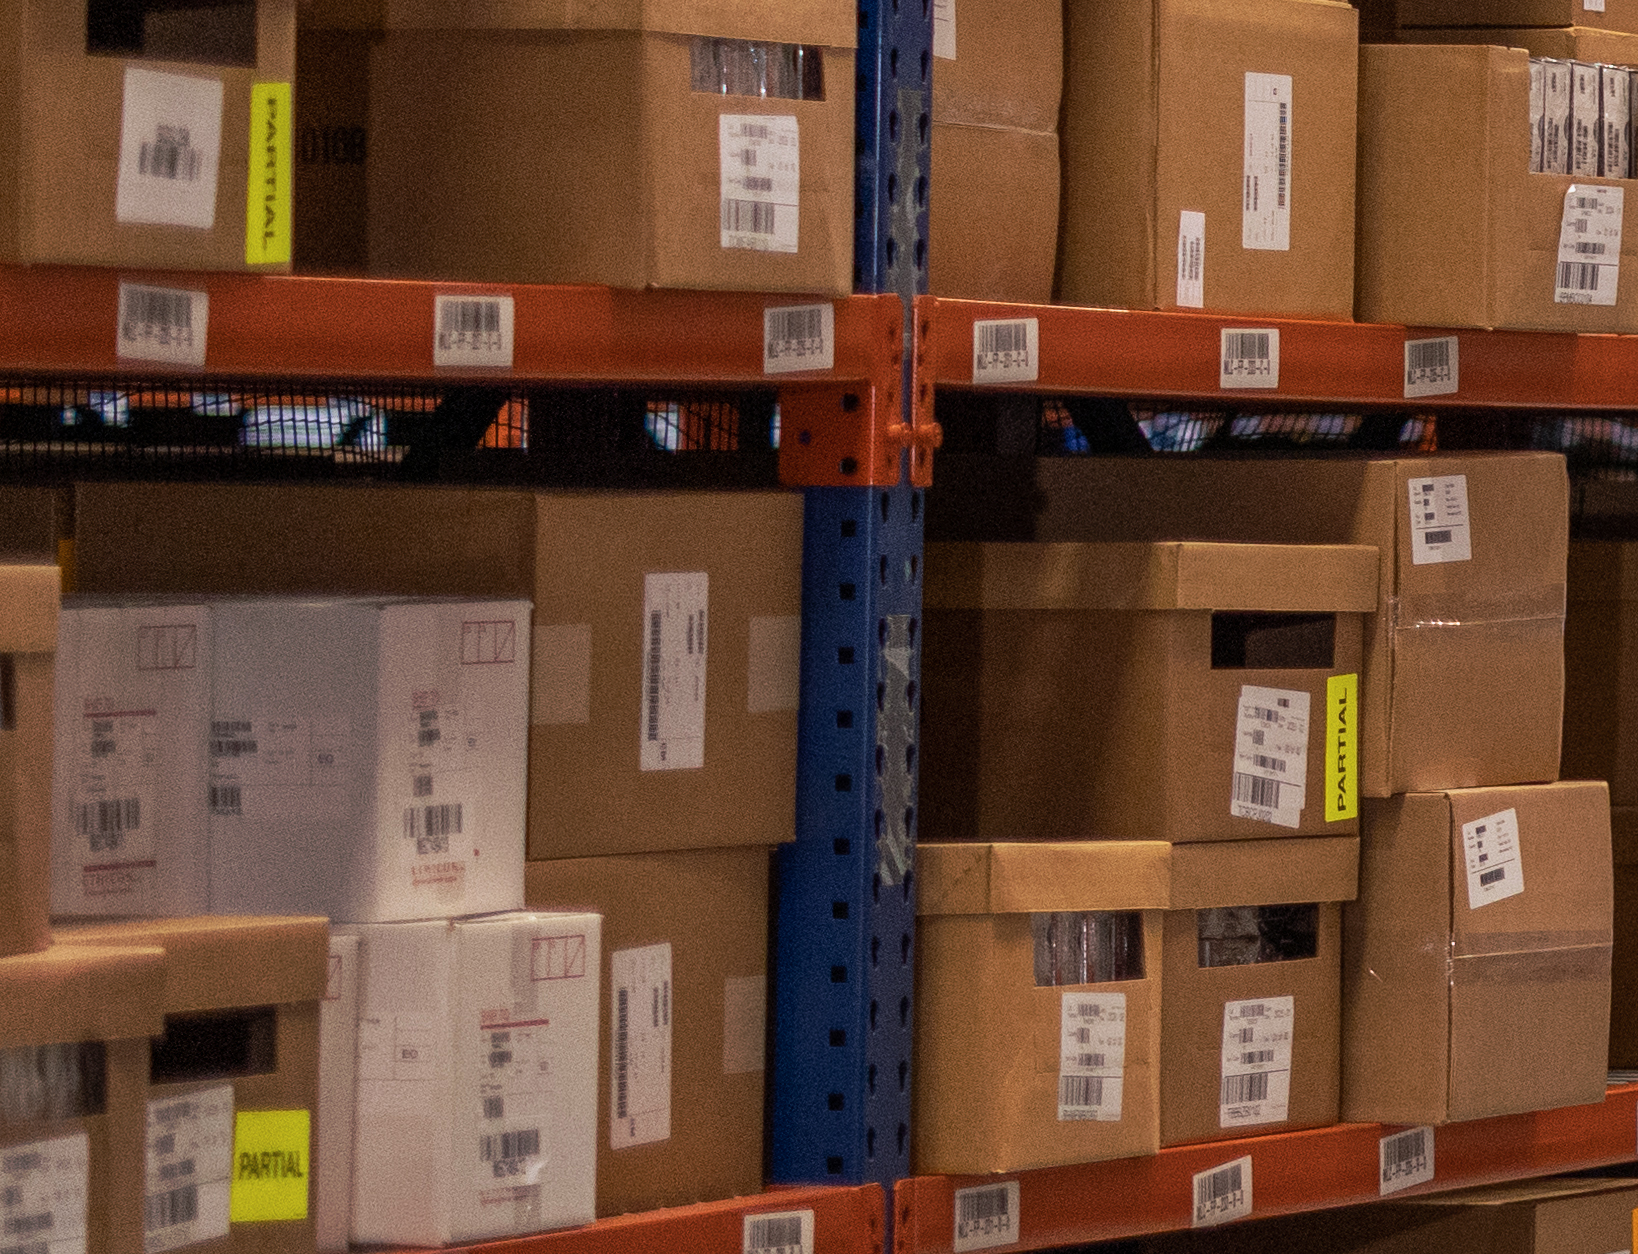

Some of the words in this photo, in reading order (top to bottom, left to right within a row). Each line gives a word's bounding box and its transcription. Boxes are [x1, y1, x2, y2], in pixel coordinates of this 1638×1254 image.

[264, 98, 277, 251] PARTIAL
[1337, 688, 1348, 812] PARTIAL
[238, 1150, 304, 1181] PARTIAL
